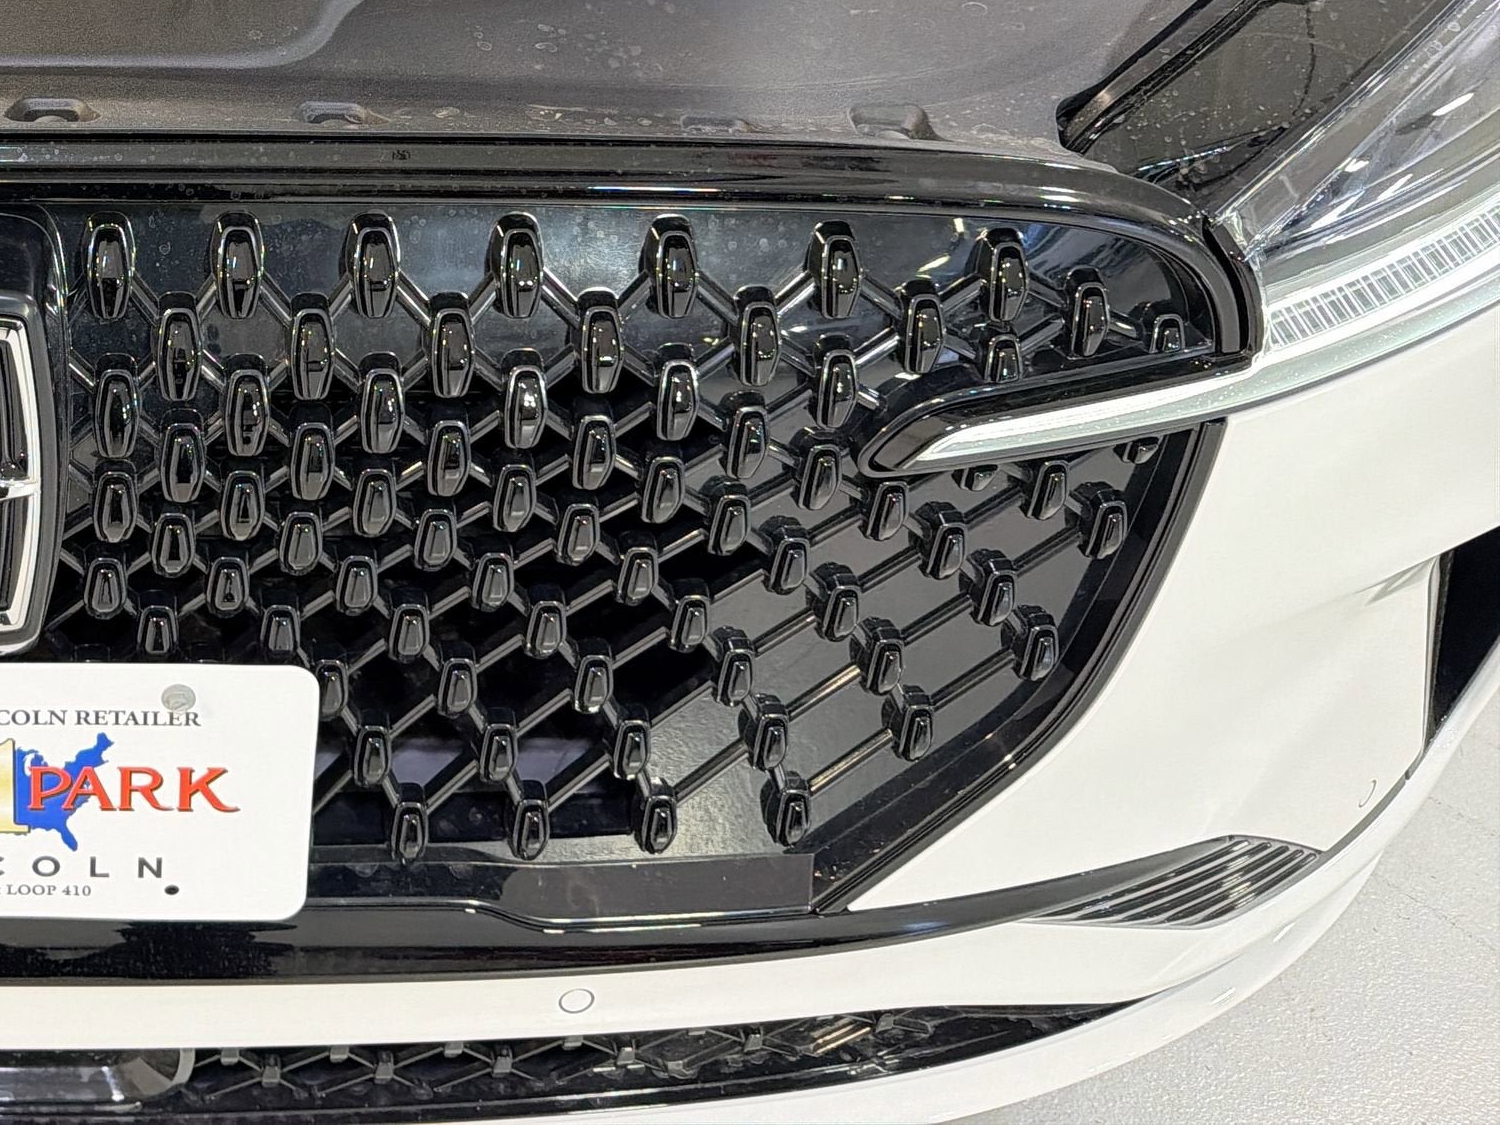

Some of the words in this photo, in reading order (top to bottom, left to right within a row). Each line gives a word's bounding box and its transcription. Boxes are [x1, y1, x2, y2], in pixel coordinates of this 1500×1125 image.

[74, 709, 202, 727] RETAILER
[28, 765, 241, 813] PARK
[6, 883, 56, 896] LOOP
[62, 884, 92, 897] 410
